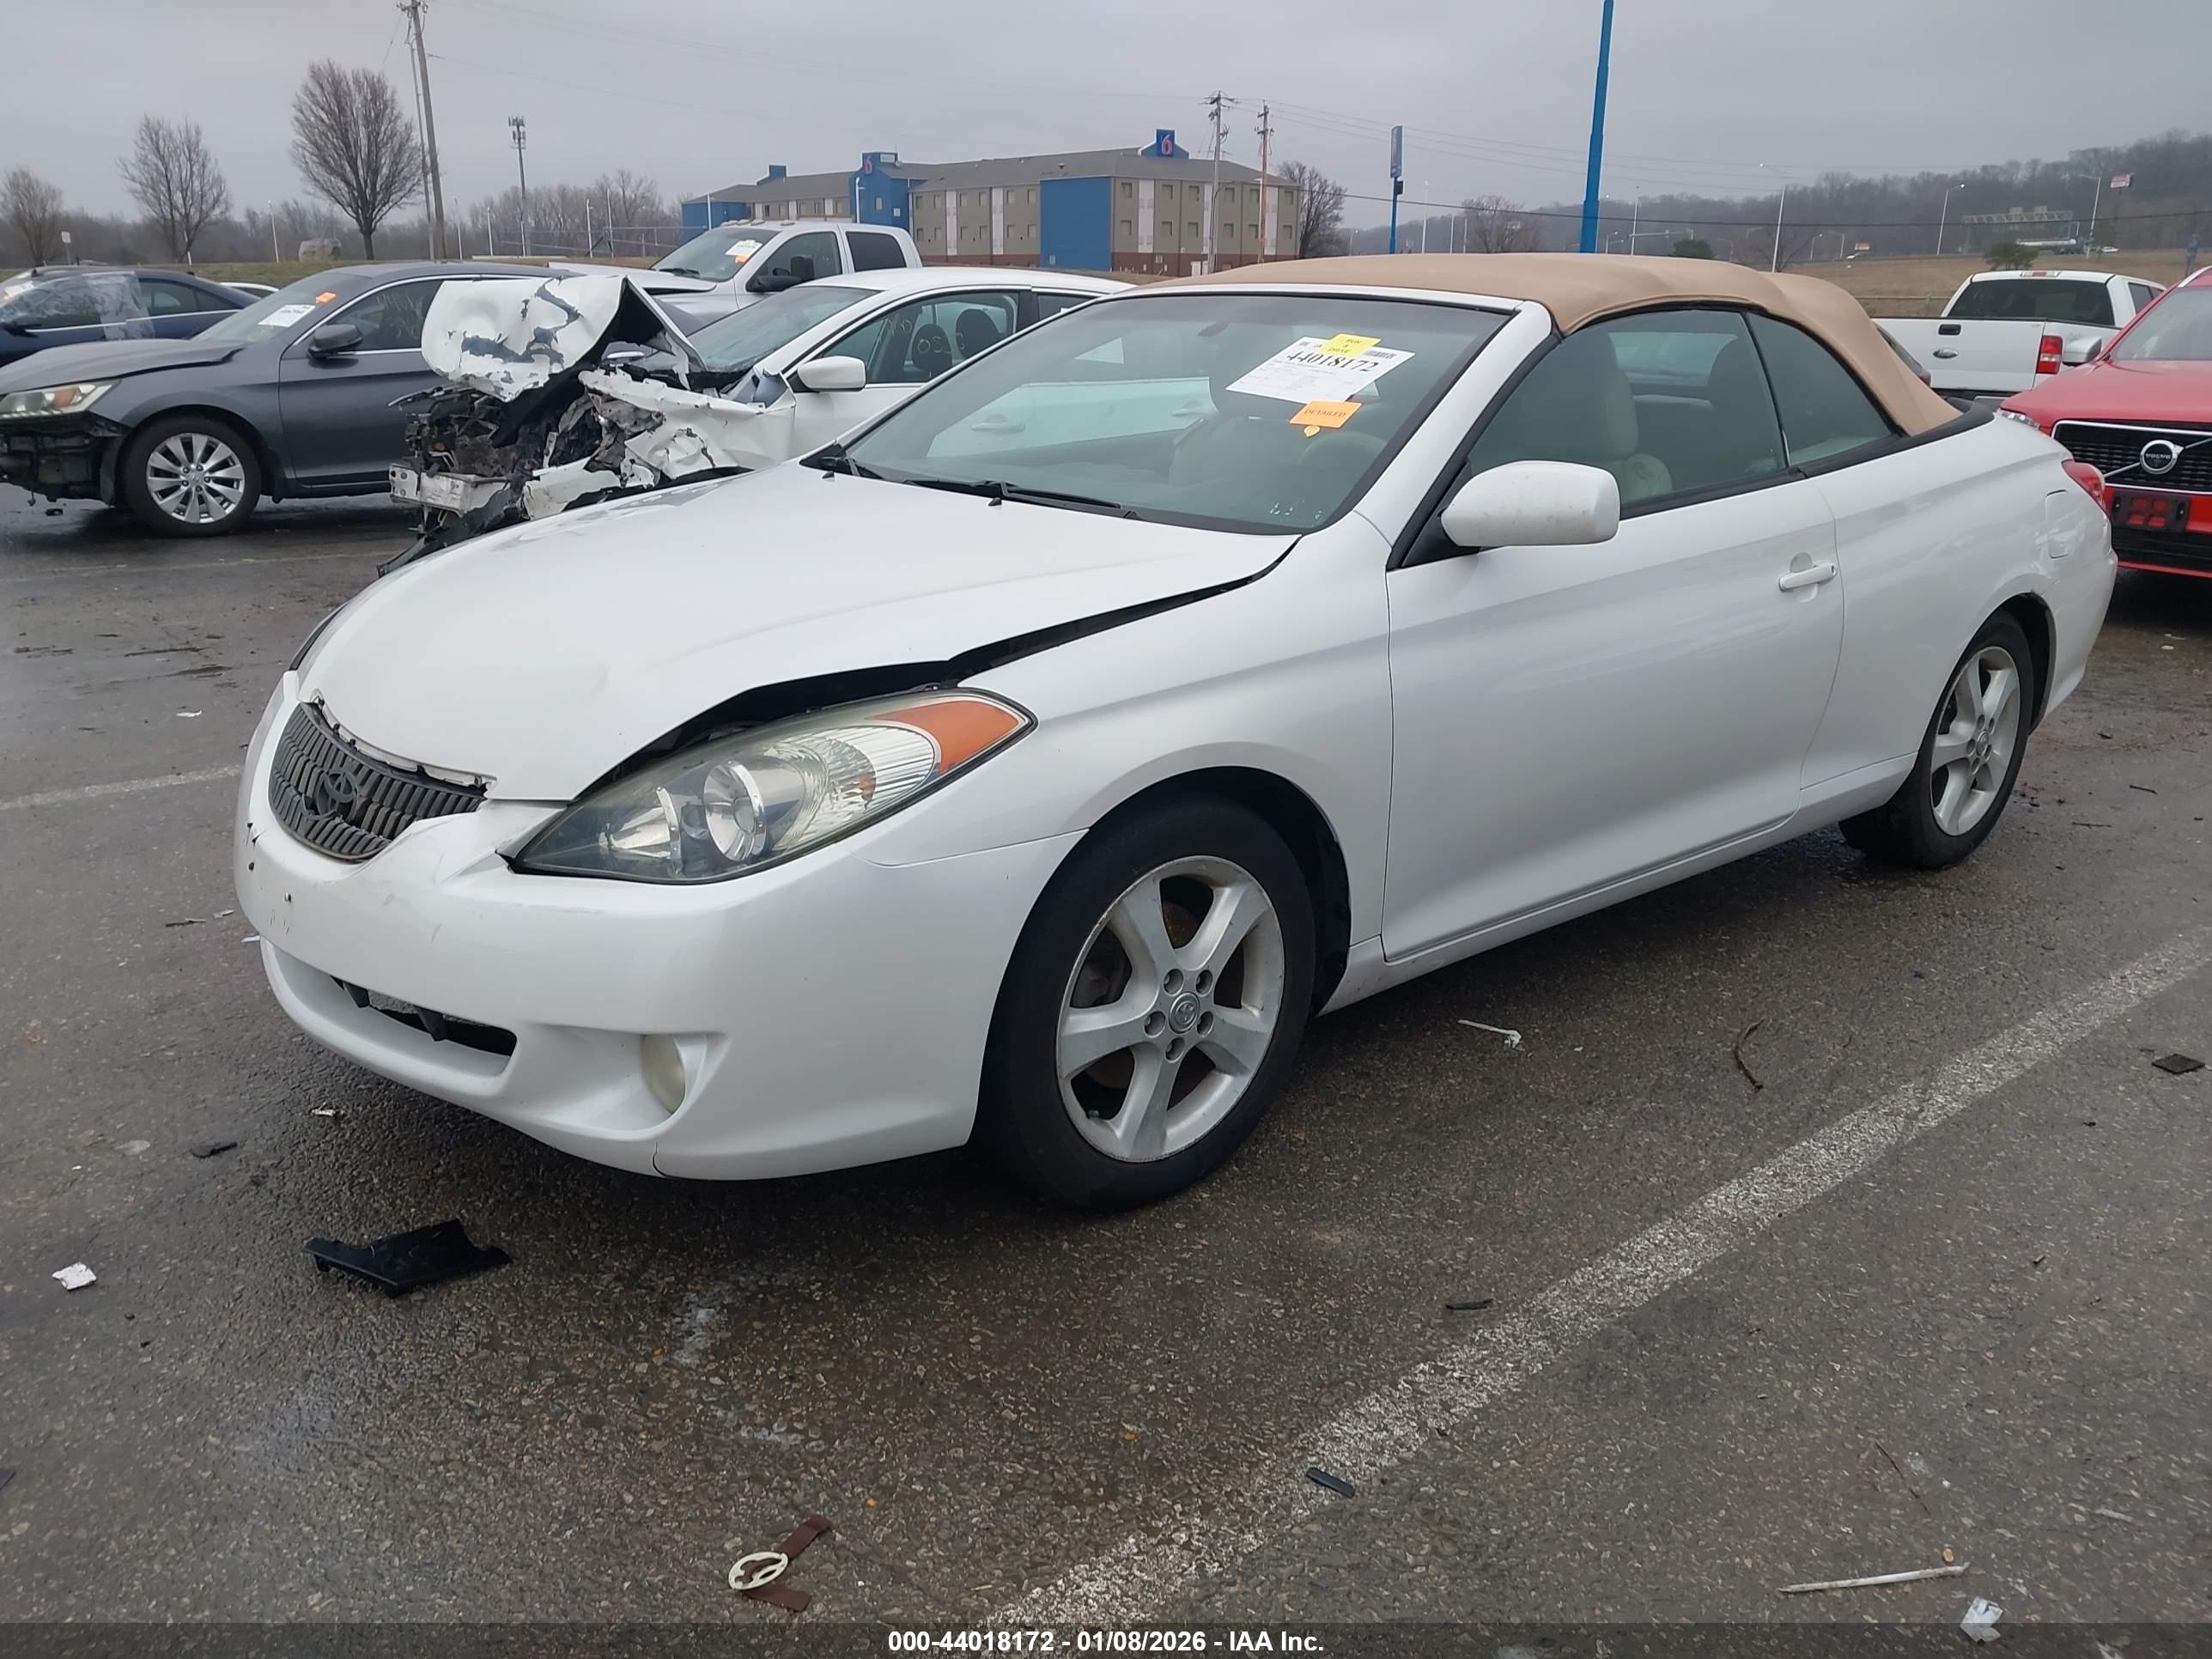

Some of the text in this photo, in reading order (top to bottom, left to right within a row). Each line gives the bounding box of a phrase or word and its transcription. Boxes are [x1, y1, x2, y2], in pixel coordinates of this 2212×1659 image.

[1162, 134, 1173, 155] 6
[866, 156, 872, 174] 6
[1287, 350, 1379, 372] 44018172
[1304, 408, 1346, 417] DETAILED
